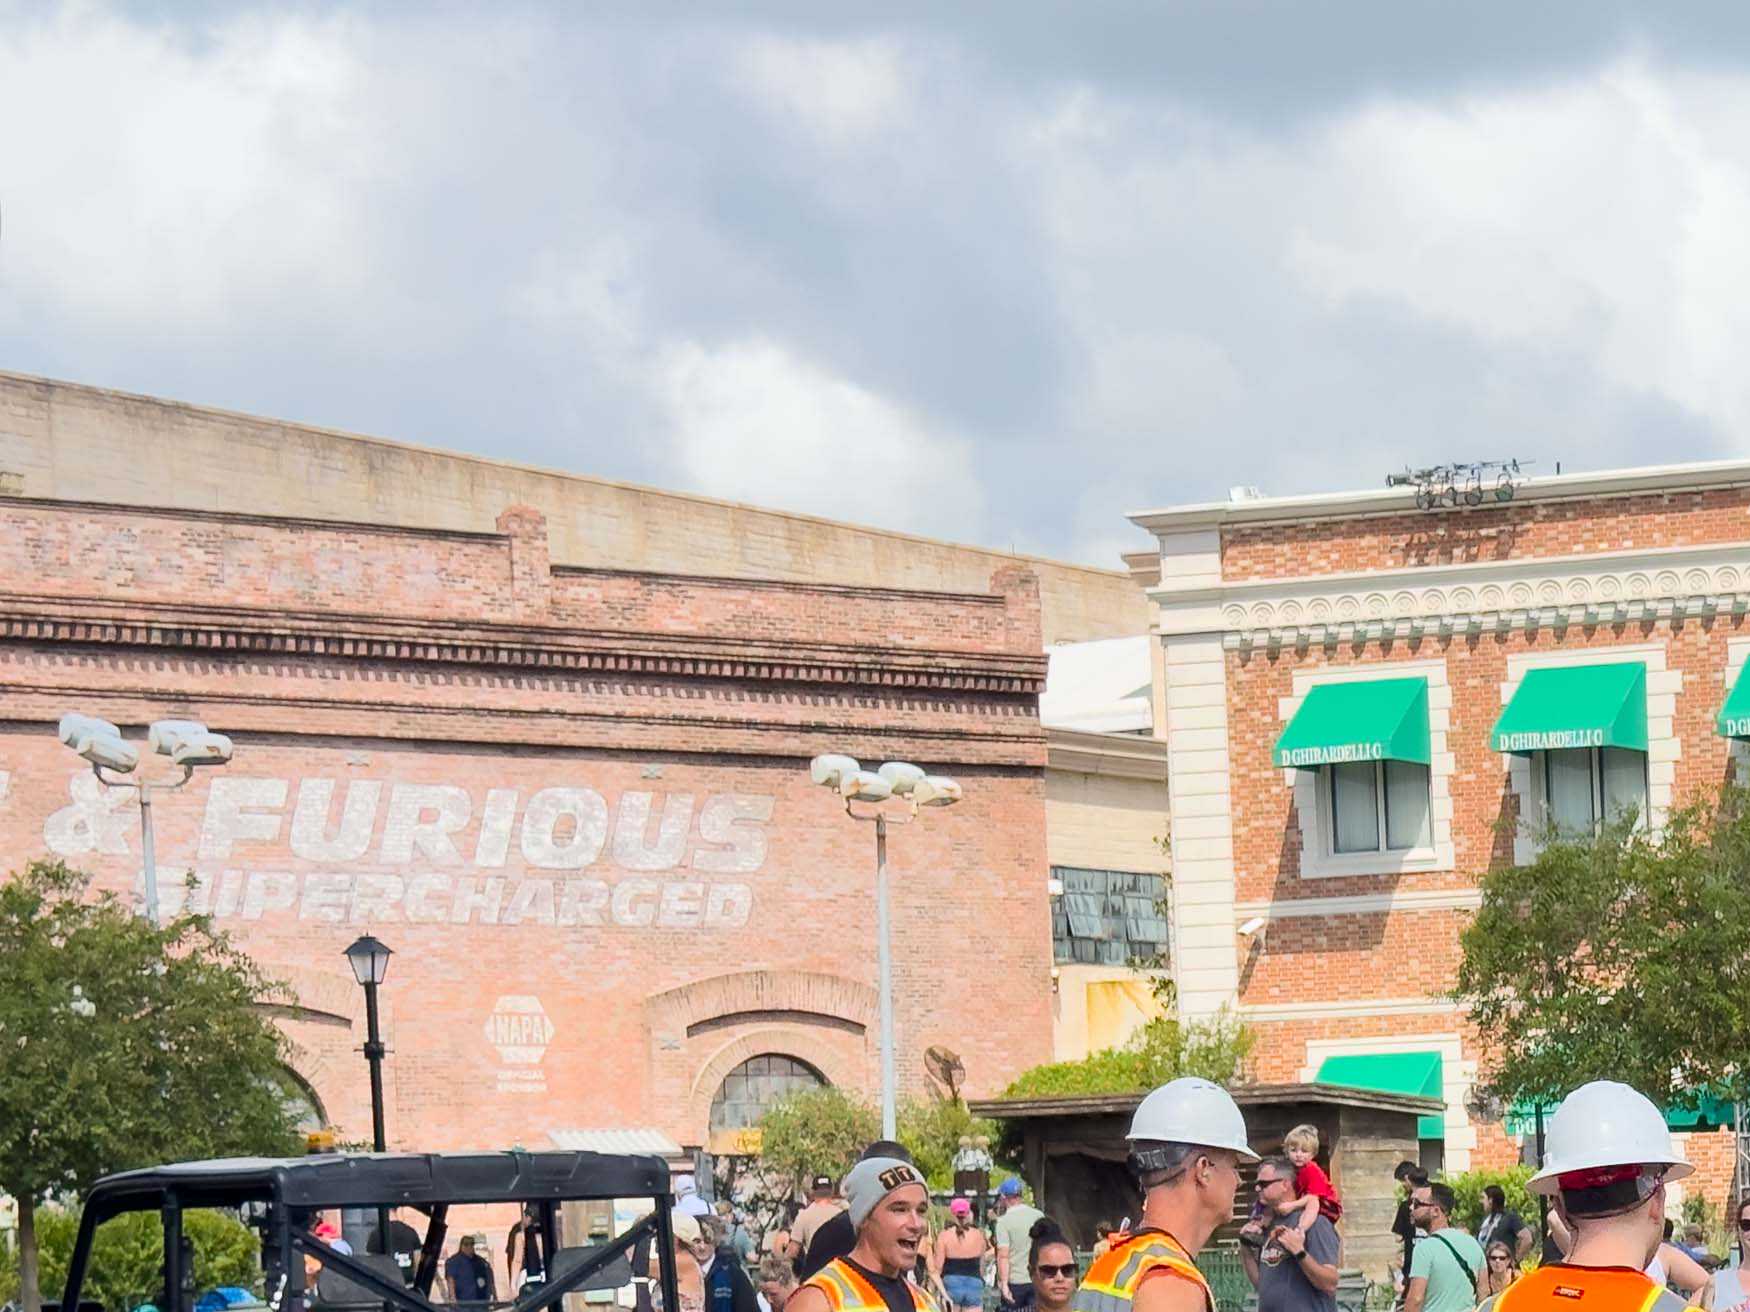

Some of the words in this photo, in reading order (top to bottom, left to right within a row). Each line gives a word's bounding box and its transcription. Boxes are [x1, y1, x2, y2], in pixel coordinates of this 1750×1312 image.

[196, 776, 776, 874] FURIOUS
[133, 866, 754, 929] SUPERCHARGED
[496, 1015, 545, 1045] NAPA
